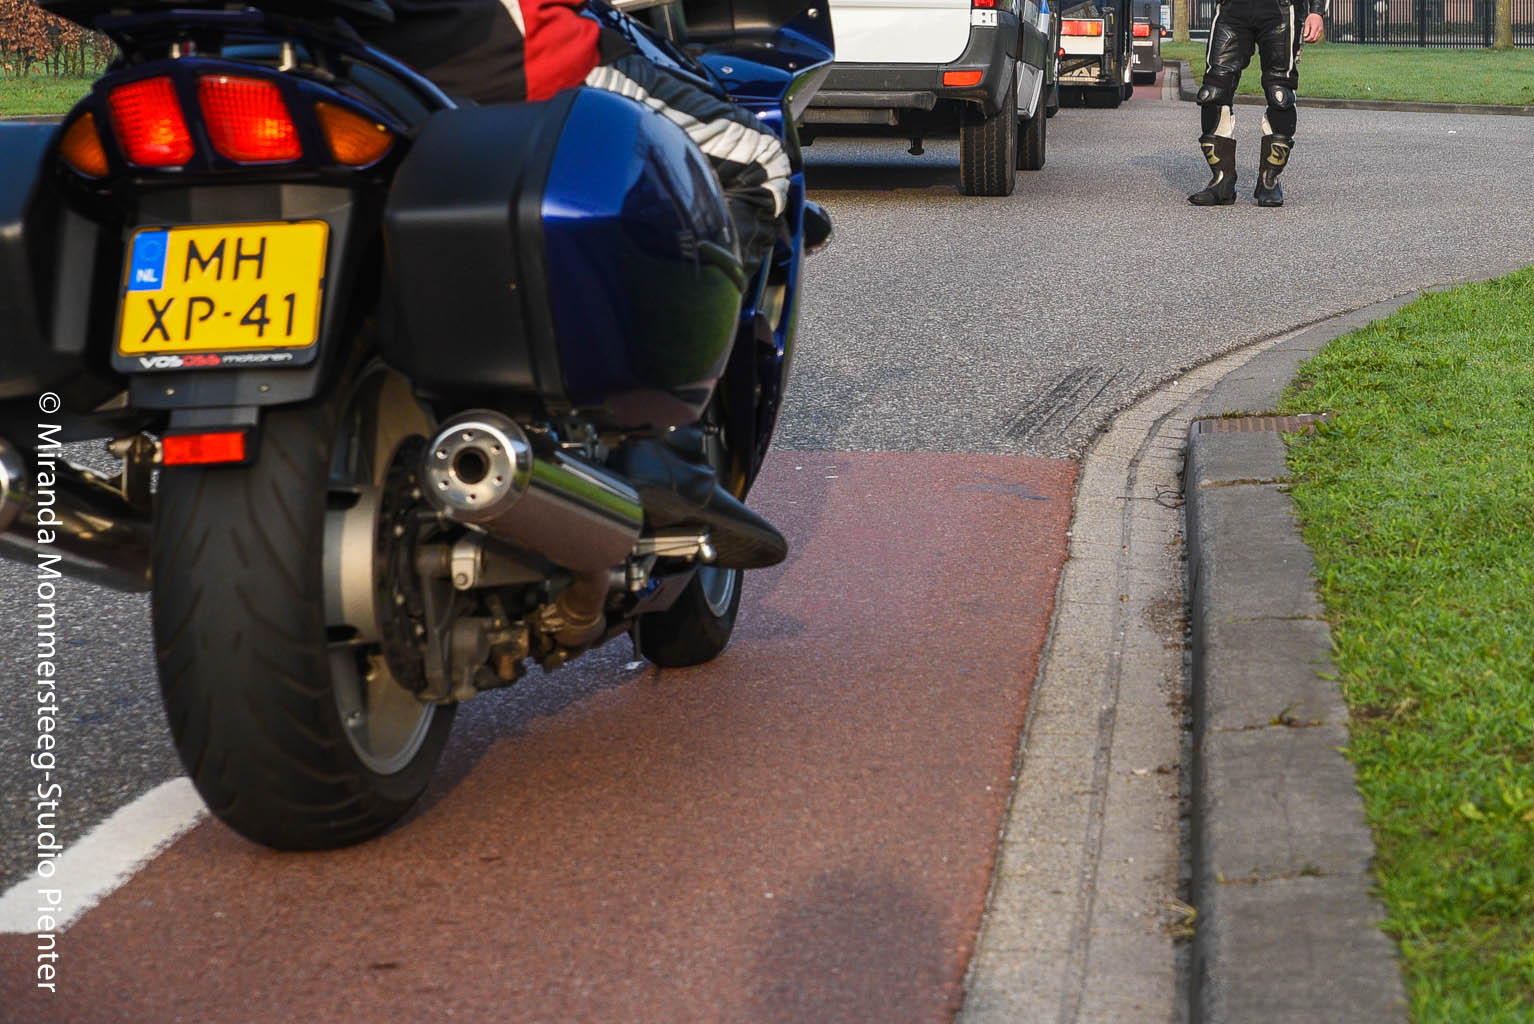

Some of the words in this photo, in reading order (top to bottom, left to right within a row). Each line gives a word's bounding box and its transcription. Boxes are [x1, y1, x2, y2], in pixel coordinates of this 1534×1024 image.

[136, 269, 159, 283] NL
[184, 237, 267, 282] MH
[142, 293, 296, 343] XP-41
